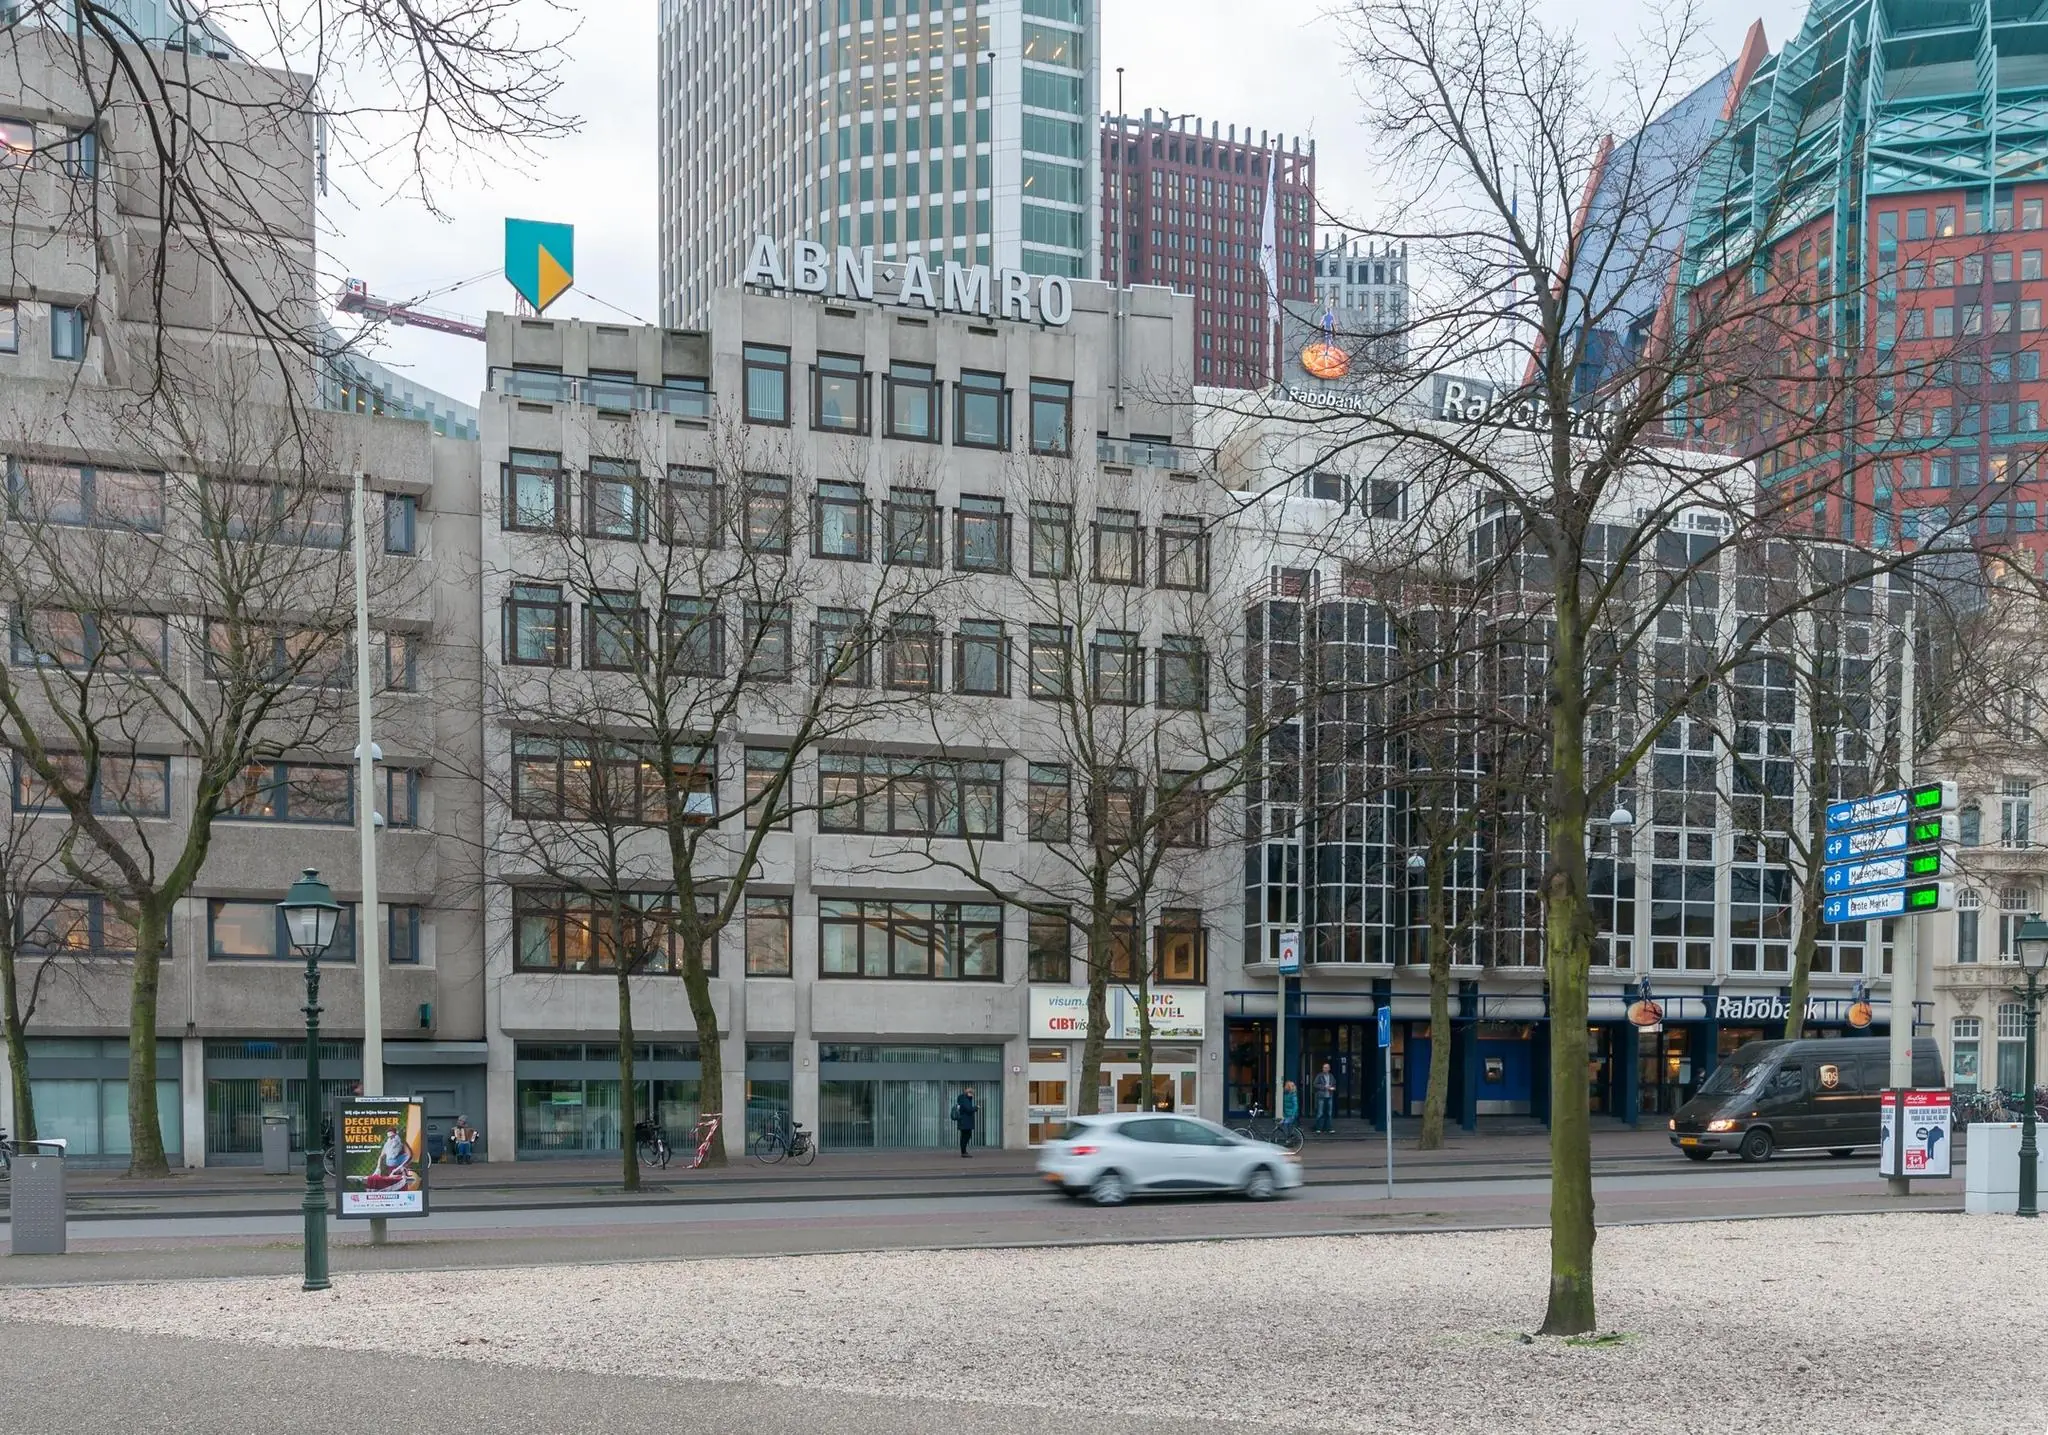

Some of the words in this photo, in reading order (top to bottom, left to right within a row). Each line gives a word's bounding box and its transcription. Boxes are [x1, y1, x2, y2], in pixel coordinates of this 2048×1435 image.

[744, 233, 874, 301] ABN
[897, 254, 1073, 325] AMRO
[1289, 386, 1362, 411] Rabobank
[1715, 996, 1818, 1020] Rabobak
[345, 1117, 400, 1126] DECEMBER
[345, 1126, 373, 1134] FEEST
[345, 1135, 381, 1143] WEKEN
